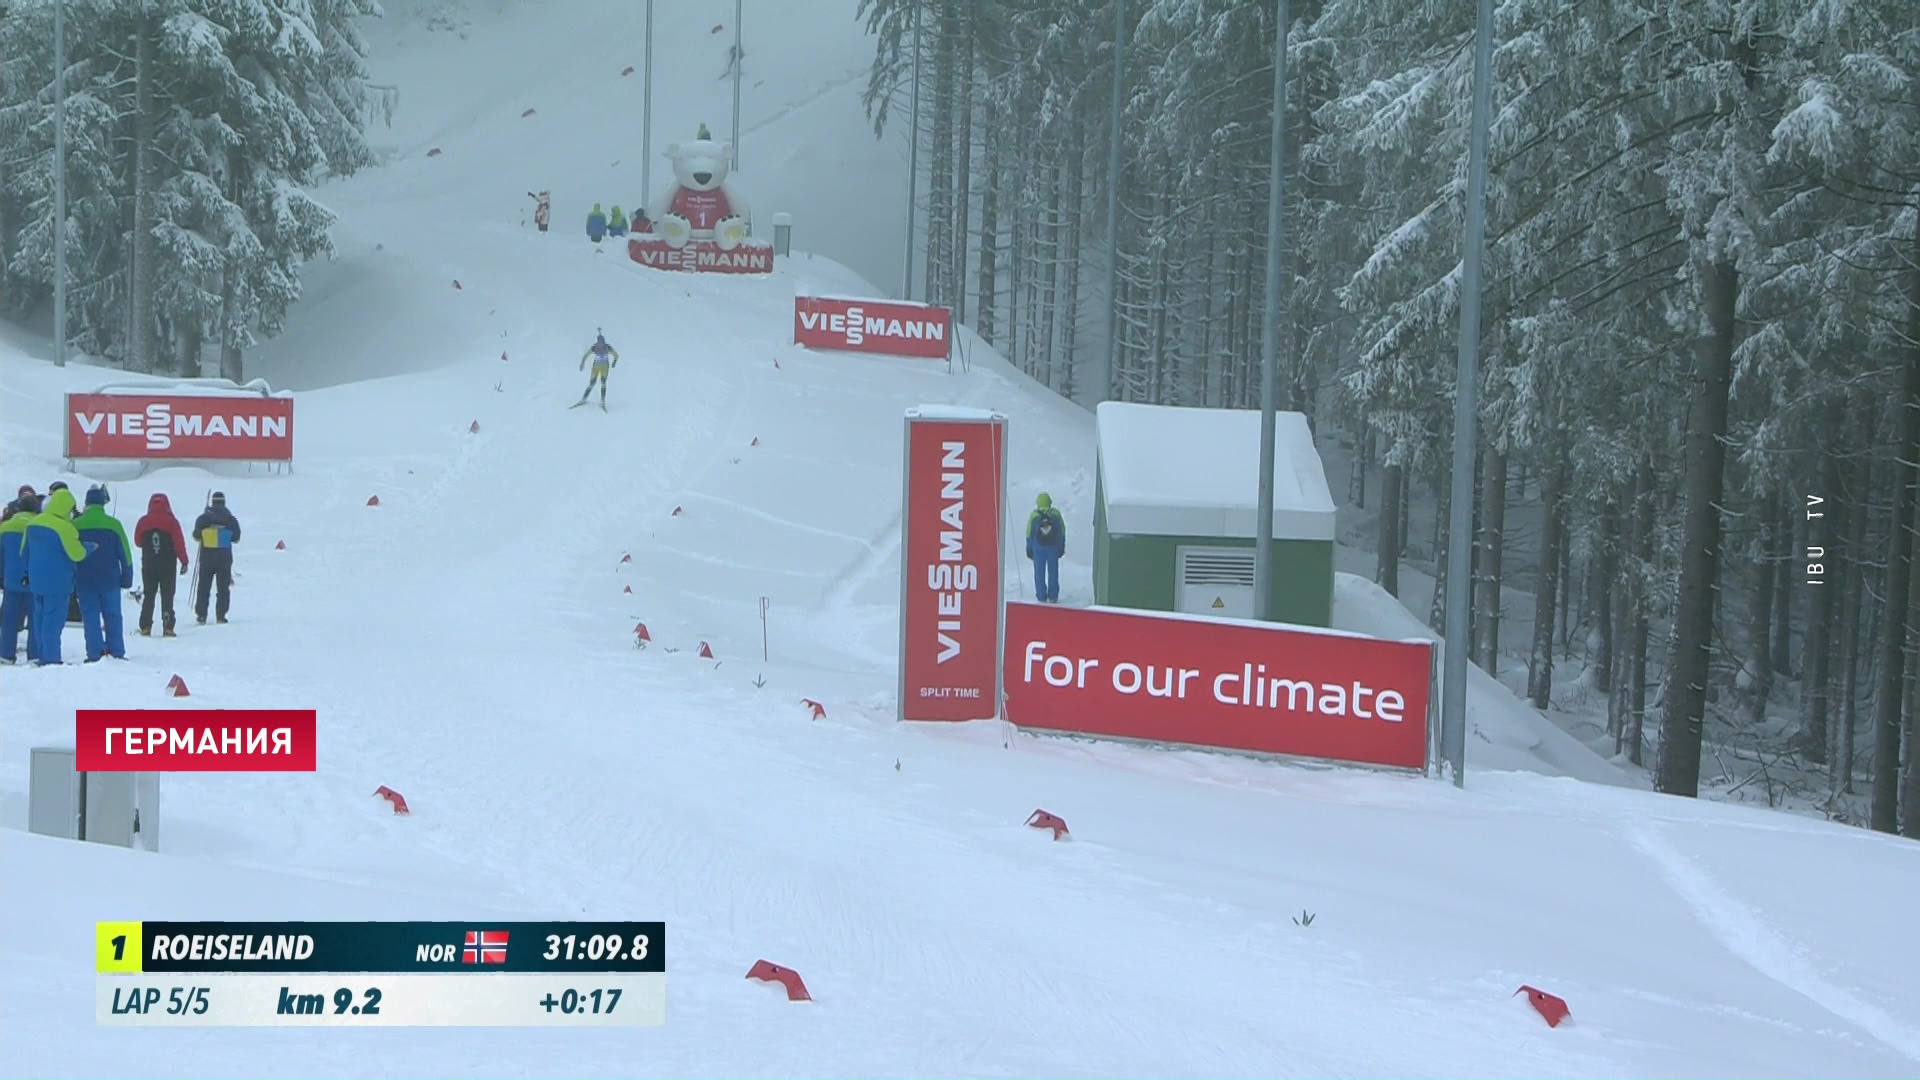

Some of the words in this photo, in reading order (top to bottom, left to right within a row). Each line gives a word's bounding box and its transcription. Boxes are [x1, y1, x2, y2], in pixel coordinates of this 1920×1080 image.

[699, 211, 706, 227] 1
[640, 243, 766, 274] VIESSMANN
[798, 306, 944, 346] VIESSMANN
[75, 403, 287, 451] VIESSMANN
[927, 441, 978, 665] VIESSMANN
[920, 687, 951, 698] SPLIT
[954, 688, 980, 699] TIME
[1023, 640, 1099, 690] for
[1111, 660, 1199, 700] our
[1212, 662, 1406, 723] climate
